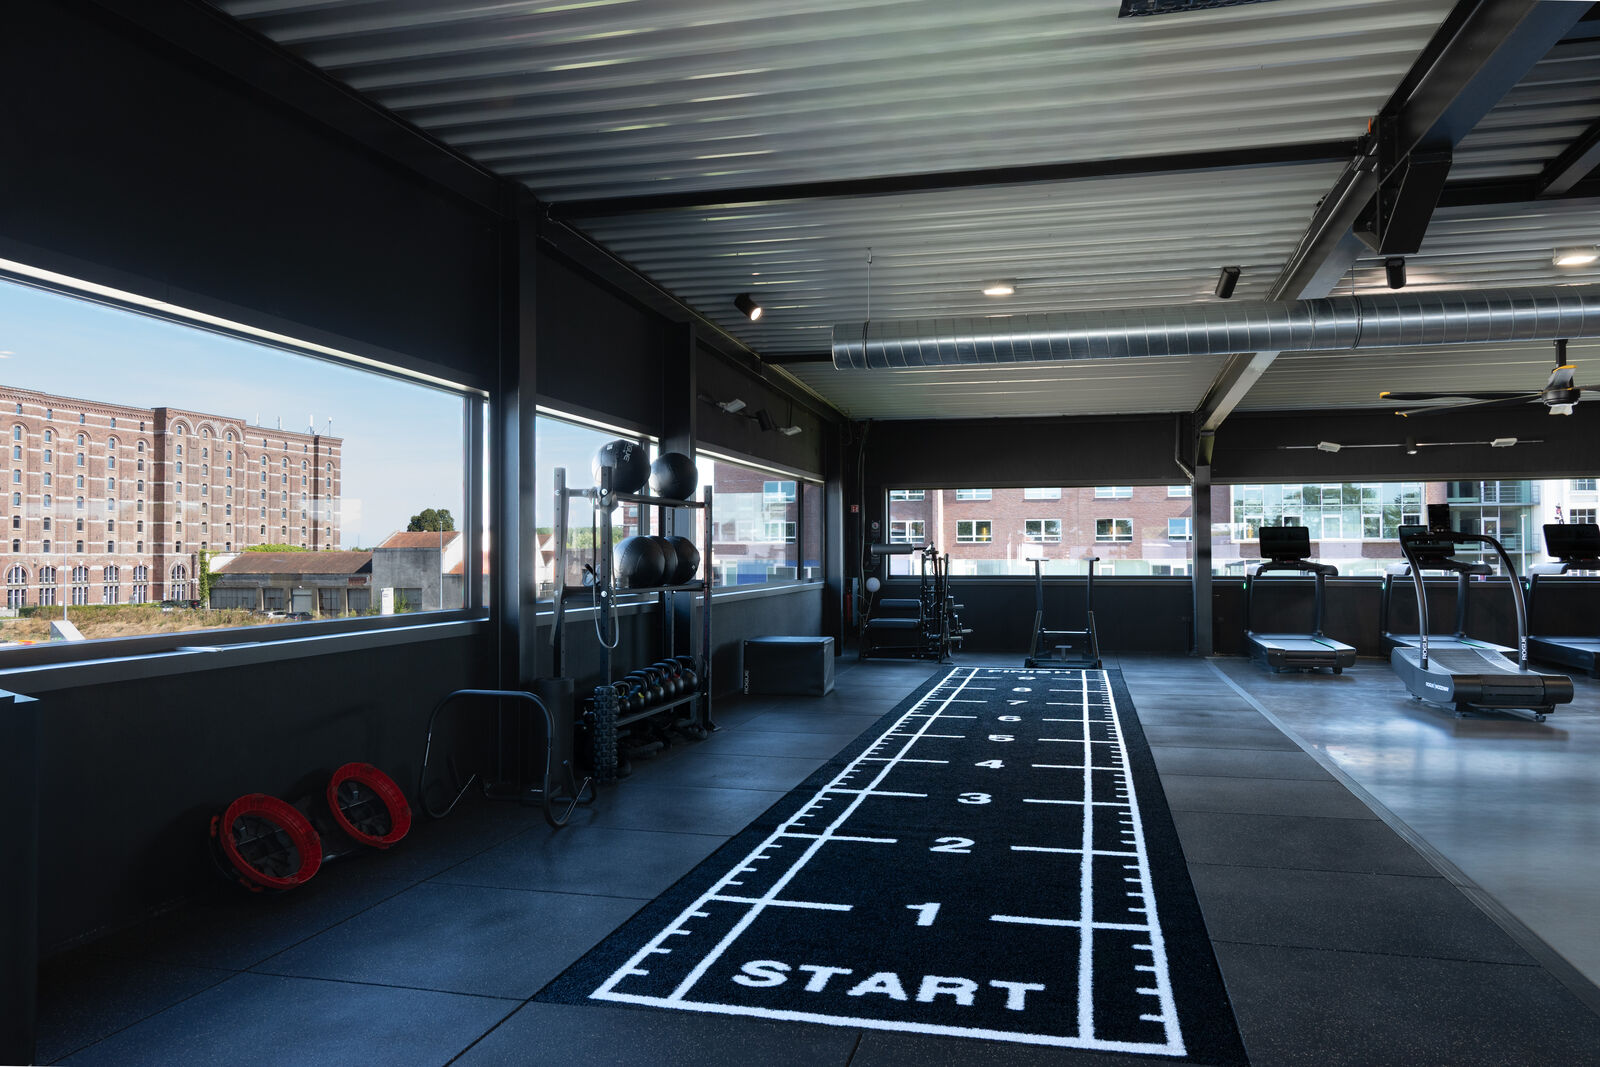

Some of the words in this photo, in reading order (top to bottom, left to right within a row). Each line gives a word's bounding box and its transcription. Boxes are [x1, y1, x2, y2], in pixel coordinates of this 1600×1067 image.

[988, 734, 1015, 742] 5
[974, 759, 1005, 769] 4
[957, 792, 992, 805] 3
[929, 836, 975, 853] 2
[905, 902, 941, 927] 1
[731, 959, 1045, 1011] START
